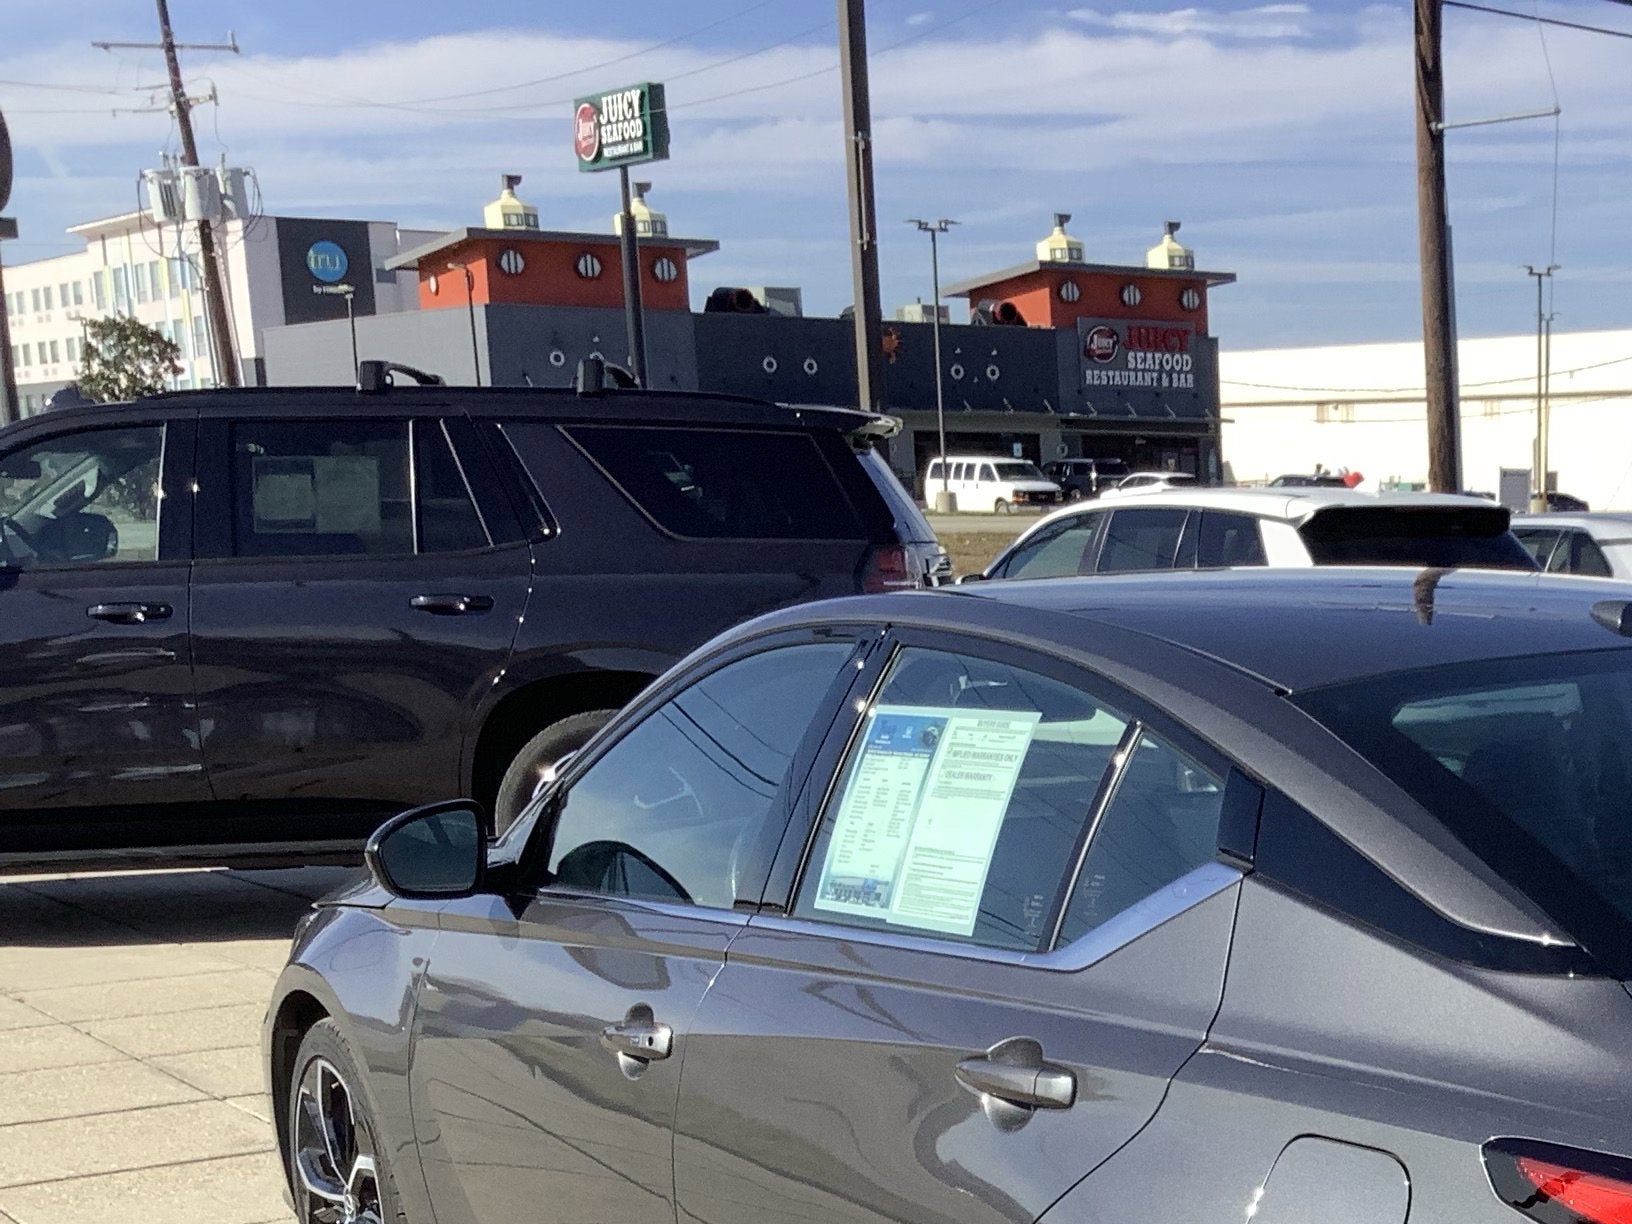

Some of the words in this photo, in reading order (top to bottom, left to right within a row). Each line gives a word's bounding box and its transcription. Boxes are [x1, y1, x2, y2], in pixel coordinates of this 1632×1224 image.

[600, 89, 640, 124] JUICY
[601, 118, 643, 144] SEAFOOD
[307, 249, 340, 270] tru
[1123, 326, 1190, 352] JUICY
[1127, 351, 1192, 371] SEAFOOD
[1085, 370, 1159, 386] RESTAURANT
[1161, 373, 1169, 387] &
[1172, 373, 1194, 388] BAR
